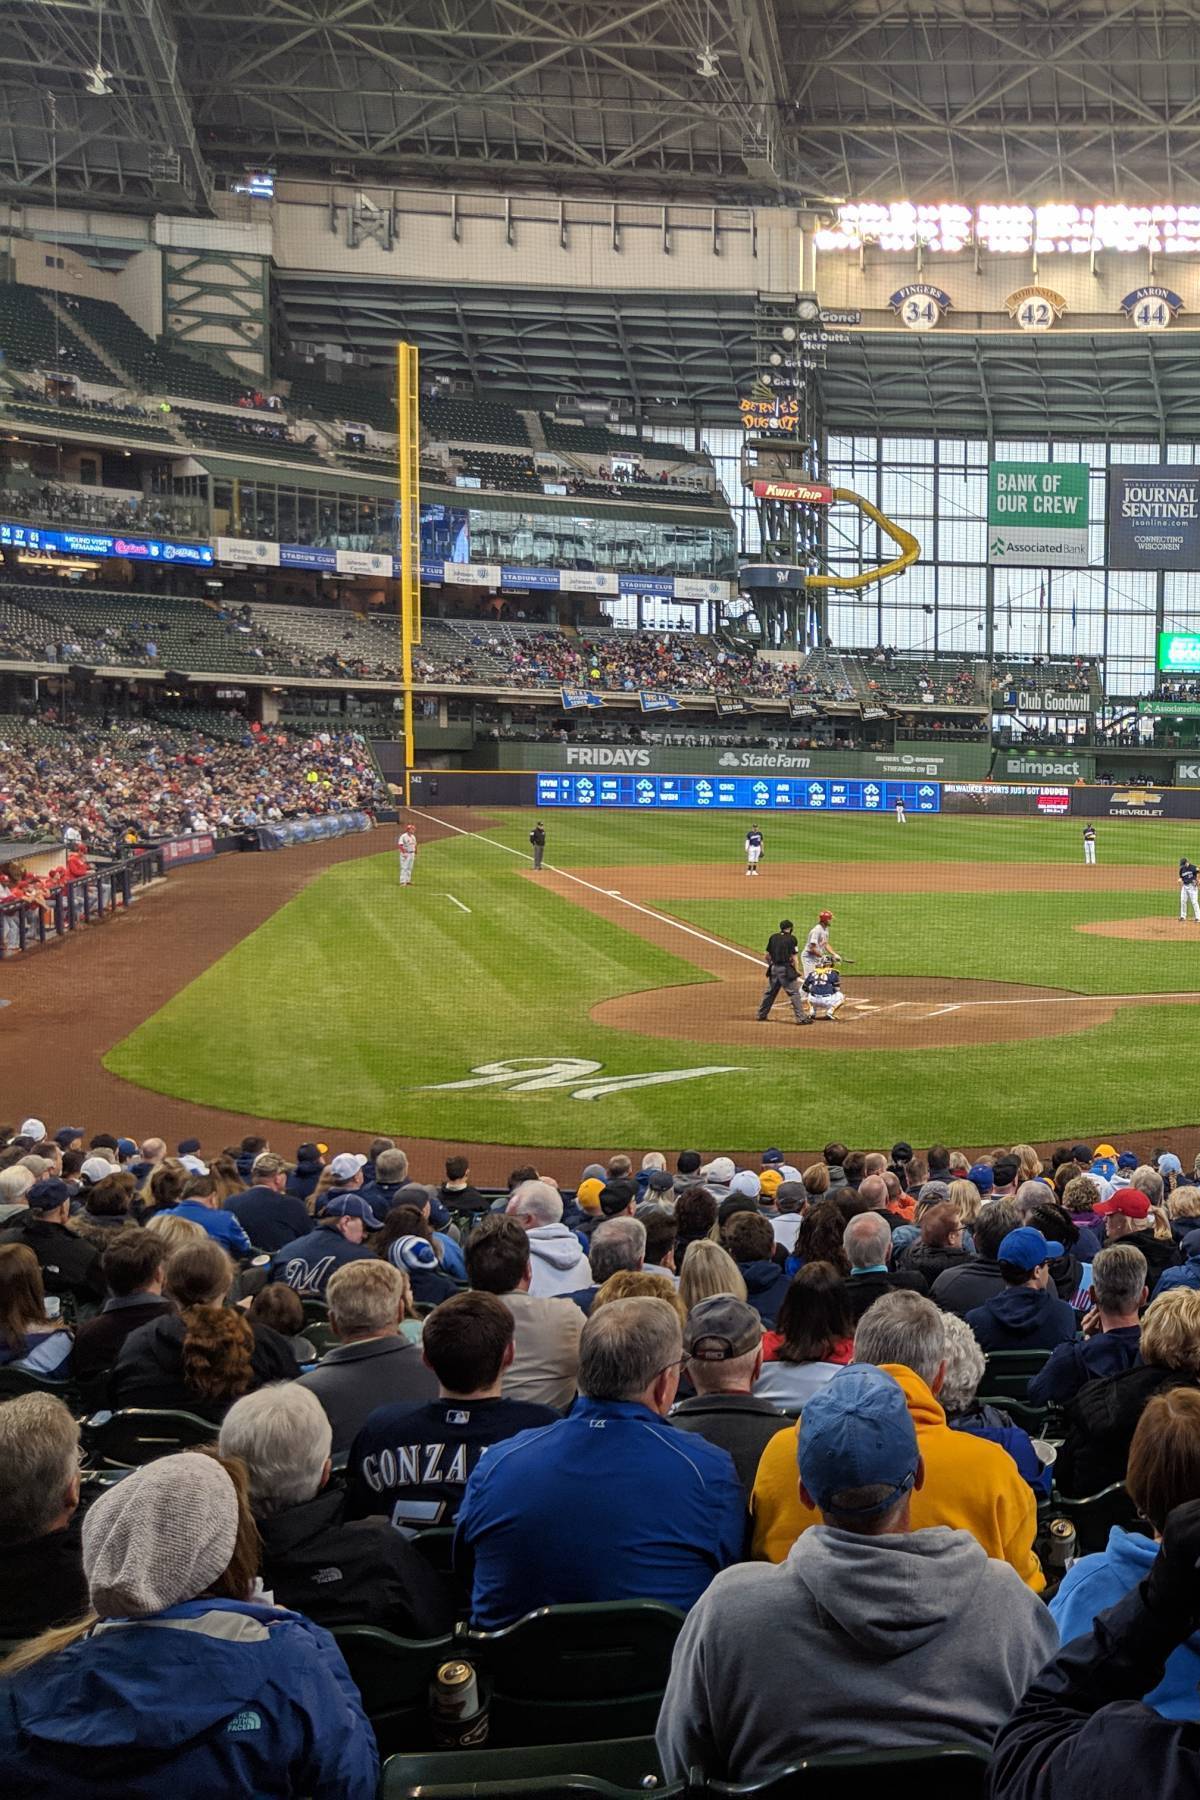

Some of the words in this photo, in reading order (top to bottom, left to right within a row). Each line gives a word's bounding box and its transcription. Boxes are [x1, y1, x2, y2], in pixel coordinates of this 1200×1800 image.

[900, 285, 942, 299] FINGERS
[1136, 288, 1169, 299] AARON
[818, 310, 862, 324] Gone!
[906, 302, 935, 323] 34
[1021, 304, 1050, 325] 42
[1137, 303, 1166, 325] 44
[799, 332, 820, 342] Get
[820, 332, 851, 343] Outta
[803, 341, 828, 351] Here
[784, 359, 799, 368] Get
[800, 359, 817, 370] Up
[773, 377, 791, 387] Get
[792, 378, 806, 388] Up
[997, 474, 1038, 492] BANK
[1042, 475, 1062, 492] OF
[765, 484, 797, 497] KWIK
[796, 486, 822, 500] TRIP
[1122, 487, 1198, 504] JOURNAL
[997, 495, 1028, 513] OUR
[1033, 496, 1078, 515] CREW
[1121, 503, 1198, 519] SENTINEL
[1132, 519, 1189, 528] jsonline.com
[2, 526, 11, 538] 24
[65, 535, 90, 545] MOUND
[92, 538, 112, 547] VISITS
[1134, 535, 1184, 544] CONNECTING
[71, 543, 107, 552] REMAINING
[1006, 542, 1062, 553] Associated
[1063, 543, 1086, 554] Bank
[1138, 543, 1180, 551] WISCONSIN
[282, 552, 314, 561] STADIUM
[503, 575, 537, 583] STADIUM
[540, 576, 558, 584] CLUB
[620, 582, 653, 590] STADIUM
[1018, 692, 1041, 711] Club
[1044, 692, 1091, 712] Goodwill
[567, 747, 650, 767] FRIDAYS
[883, 765, 916, 773] STREAMING
[1020, 758, 1080, 777] impact
[944, 785, 983, 793] MILWAUKEE
[984, 785, 1009, 794] SPORTS
[1010, 786, 1025, 794] JUST
[1027, 786, 1040, 795] GOT
[1040, 787, 1069, 795] LOUDER
[1109, 809, 1164, 817] CHEVROLET
[286, 1255, 337, 1293] M
[363, 1444, 489, 1493] GONZA
